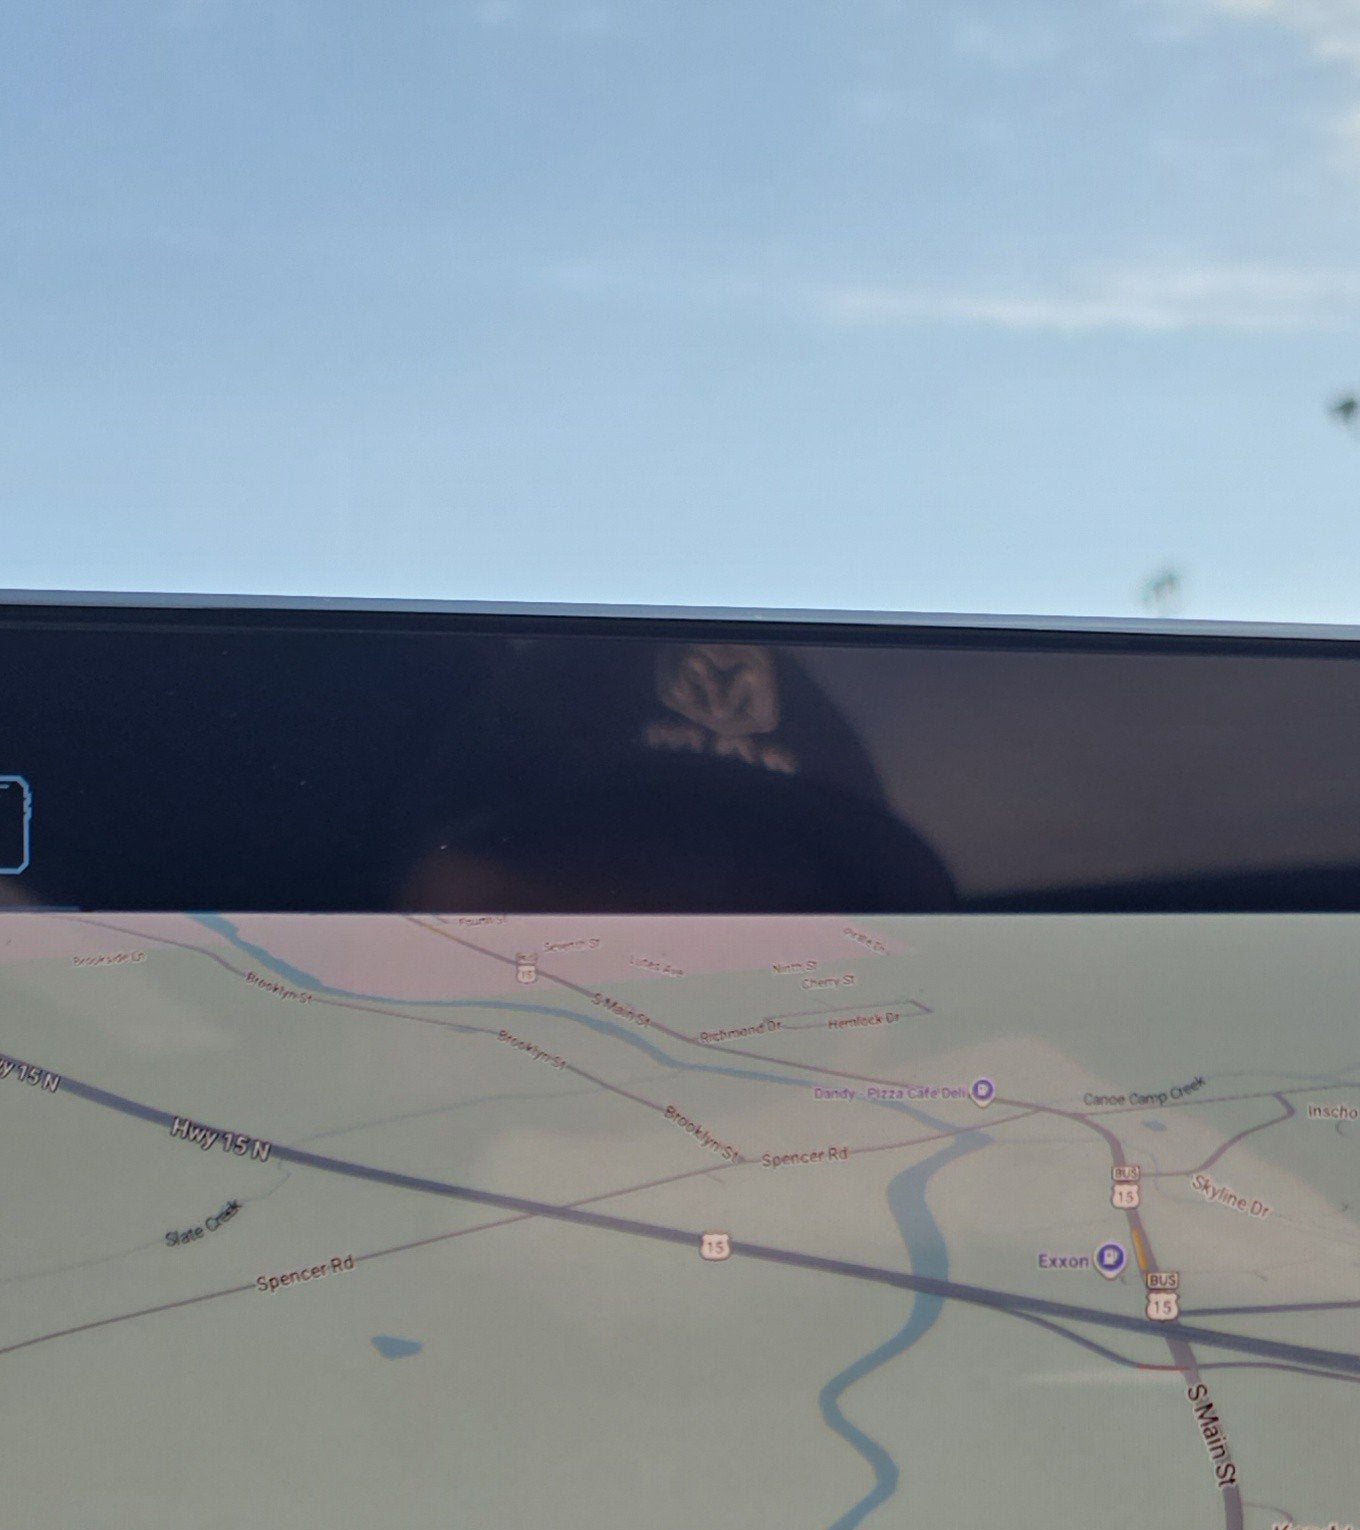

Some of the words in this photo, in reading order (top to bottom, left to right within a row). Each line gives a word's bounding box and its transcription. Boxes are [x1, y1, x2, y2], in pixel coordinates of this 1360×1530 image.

[246, 970, 300, 1001] Brooklyn
[497, 1029, 554, 1063] Brooklyn
[551, 1055, 567, 1069] St
[16, 1063, 42, 1086] 15
[42, 1073, 62, 1093] N
[814, 1087, 855, 1102] Dandy
[867, 1087, 903, 1099] Pizza
[942, 1087, 967, 1099] Deli
[1083, 1092, 1126, 1107] Canoe
[1128, 1091, 1168, 1107] Camp
[1170, 1076, 1206, 1100] Creek
[170, 1116, 220, 1150] Hwy
[223, 1131, 249, 1157] 15
[251, 1138, 273, 1163] N
[664, 1104, 721, 1152] Brooklyn
[721, 1144, 740, 1163] St
[761, 1149, 823, 1169] Spencer
[827, 1147, 848, 1162] Rd
[1114, 1167, 1139, 1179] BUS
[1117, 1190, 1135, 1204] 15
[1191, 1174, 1247, 1212] Skyline
[1249, 1200, 1270, 1218] Dr
[165, 1225, 204, 1247] Slate
[706, 1240, 725, 1254] 15
[256, 1262, 327, 1293] Spencer
[326, 1254, 356, 1276] Rd
[1038, 1254, 1090, 1270] Exxon
[1149, 1273, 1177, 1288] BUS
[1153, 1299, 1173, 1315] 15
[1187, 1384, 1208, 1402] S
[1196, 1402, 1226, 1460] Main
[1216, 1462, 1237, 1488] St
